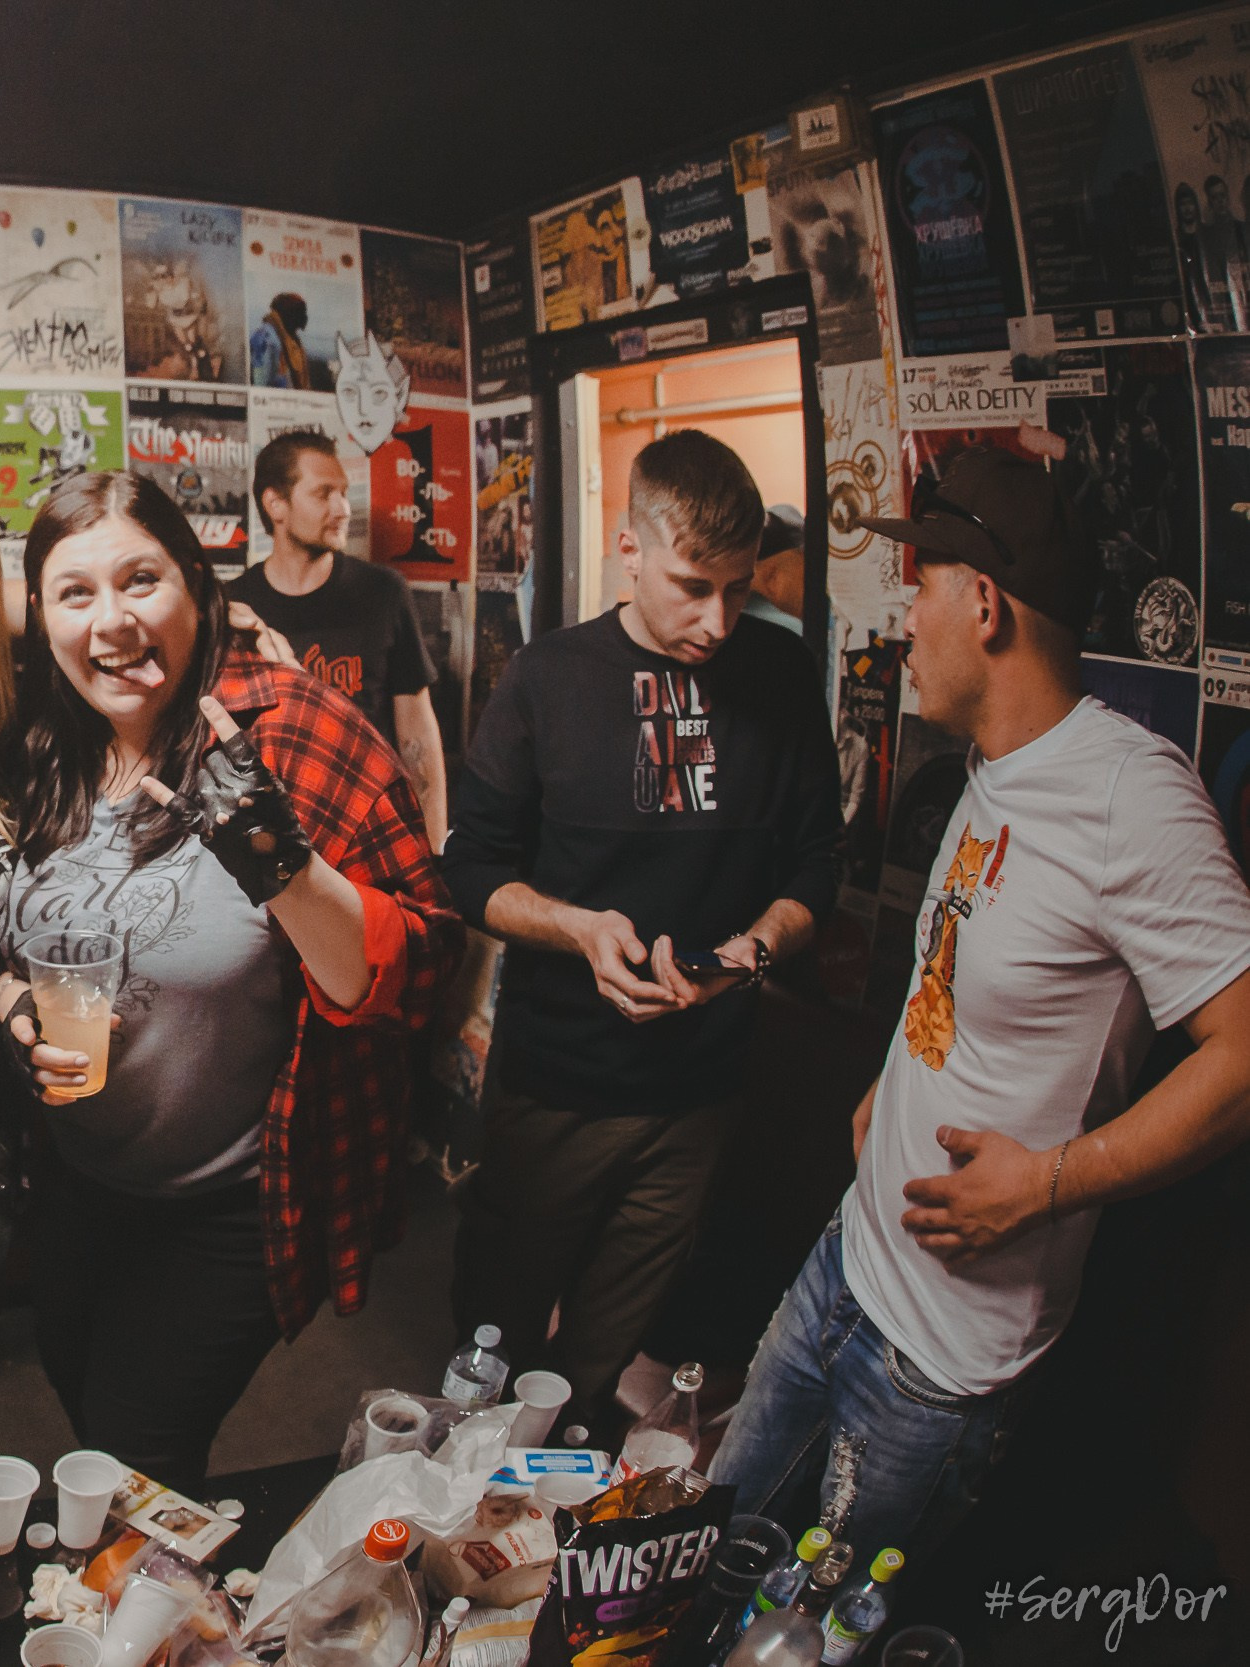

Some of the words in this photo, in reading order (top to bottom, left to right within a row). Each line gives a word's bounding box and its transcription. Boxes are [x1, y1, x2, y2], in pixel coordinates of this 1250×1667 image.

[902, 367, 916, 385] 17
[906, 388, 972, 415] SOLAR
[976, 386, 1038, 412] DEITY
[1204, 677, 1226, 699] 09
[676, 719, 710, 737] BEST
[558, 1524, 720, 1600] TWISTER
